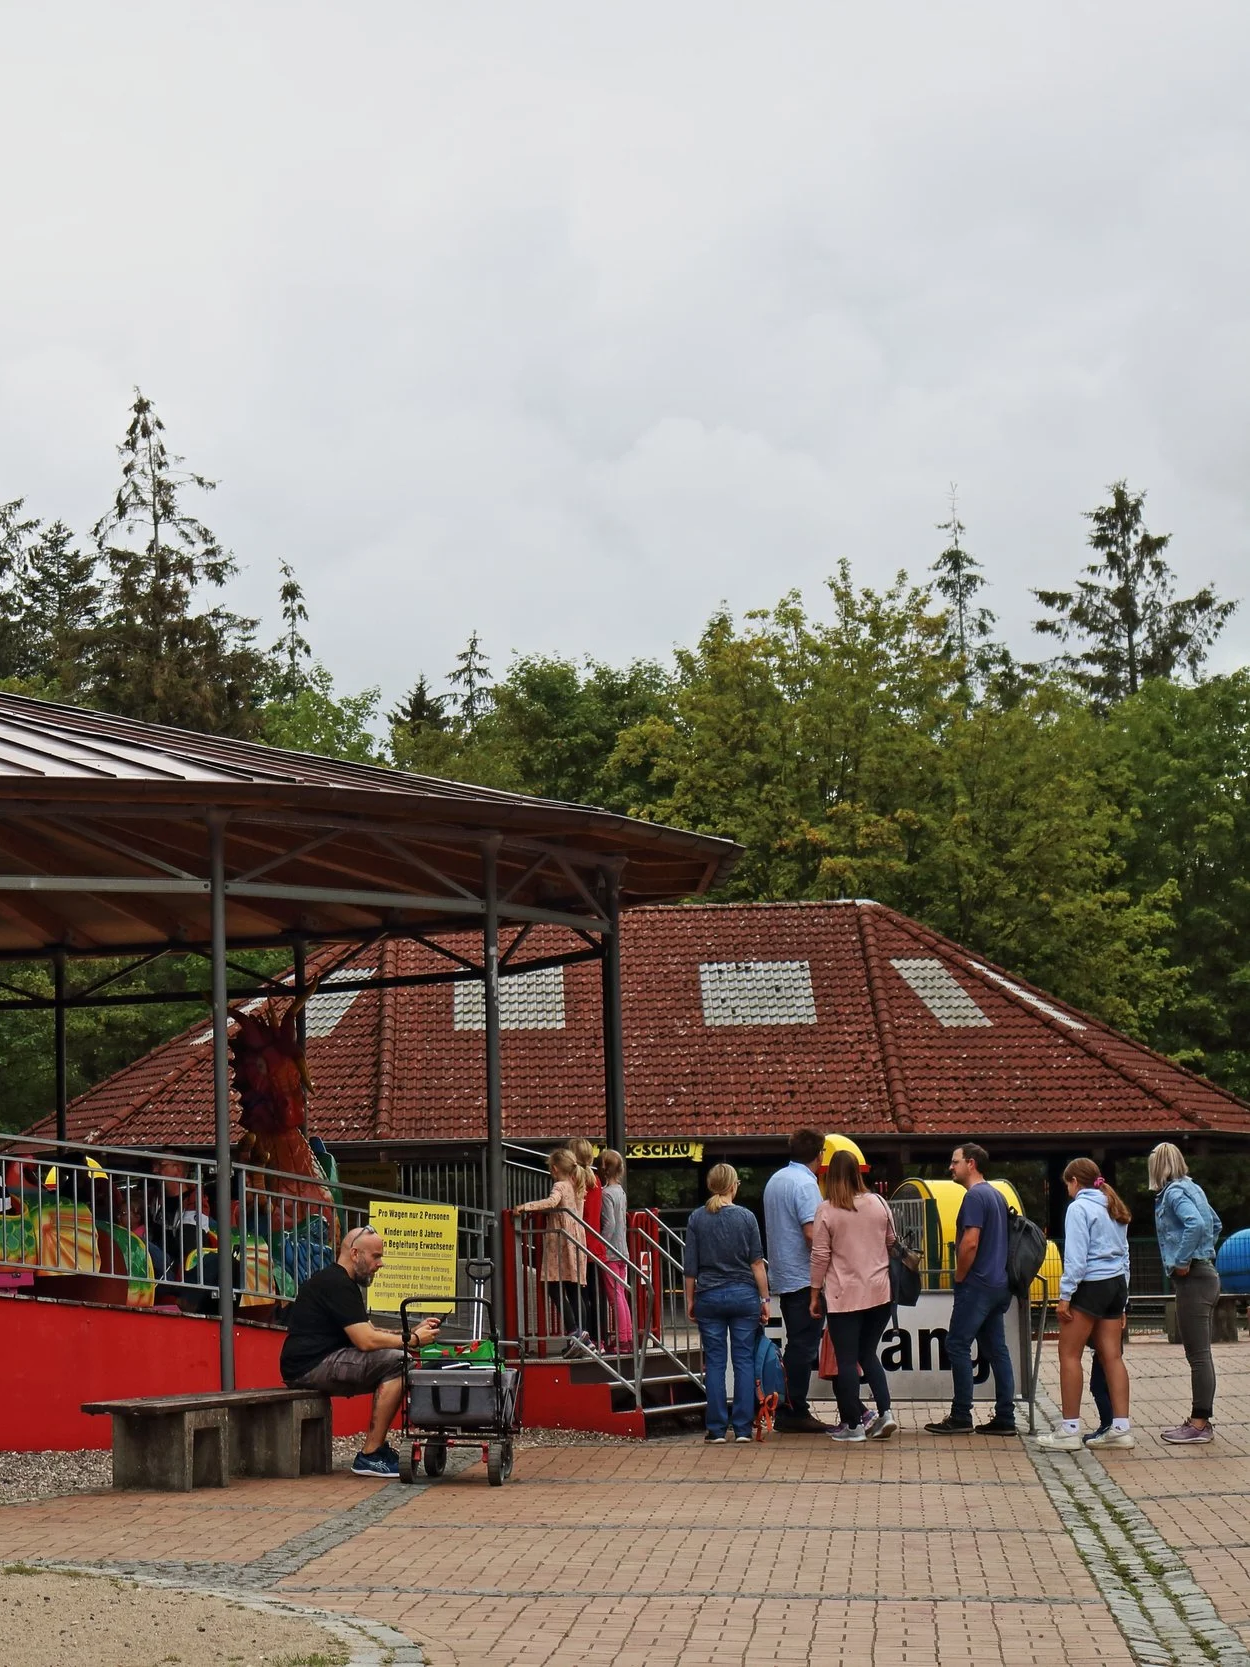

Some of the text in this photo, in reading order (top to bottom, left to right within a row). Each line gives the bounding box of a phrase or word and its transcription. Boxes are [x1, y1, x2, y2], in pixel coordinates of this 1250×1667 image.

[378, 1209, 388, 1218] Pro
[389, 1210, 408, 1220] Wagen
[419, 1211, 424, 1219] 2
[425, 1211, 449, 1221] Personen
[383, 1227, 443, 1239] Kinder unter 8 Jahren
[388, 1240, 418, 1251] Begleitung
[419, 1241, 455, 1252] Erwachsener
